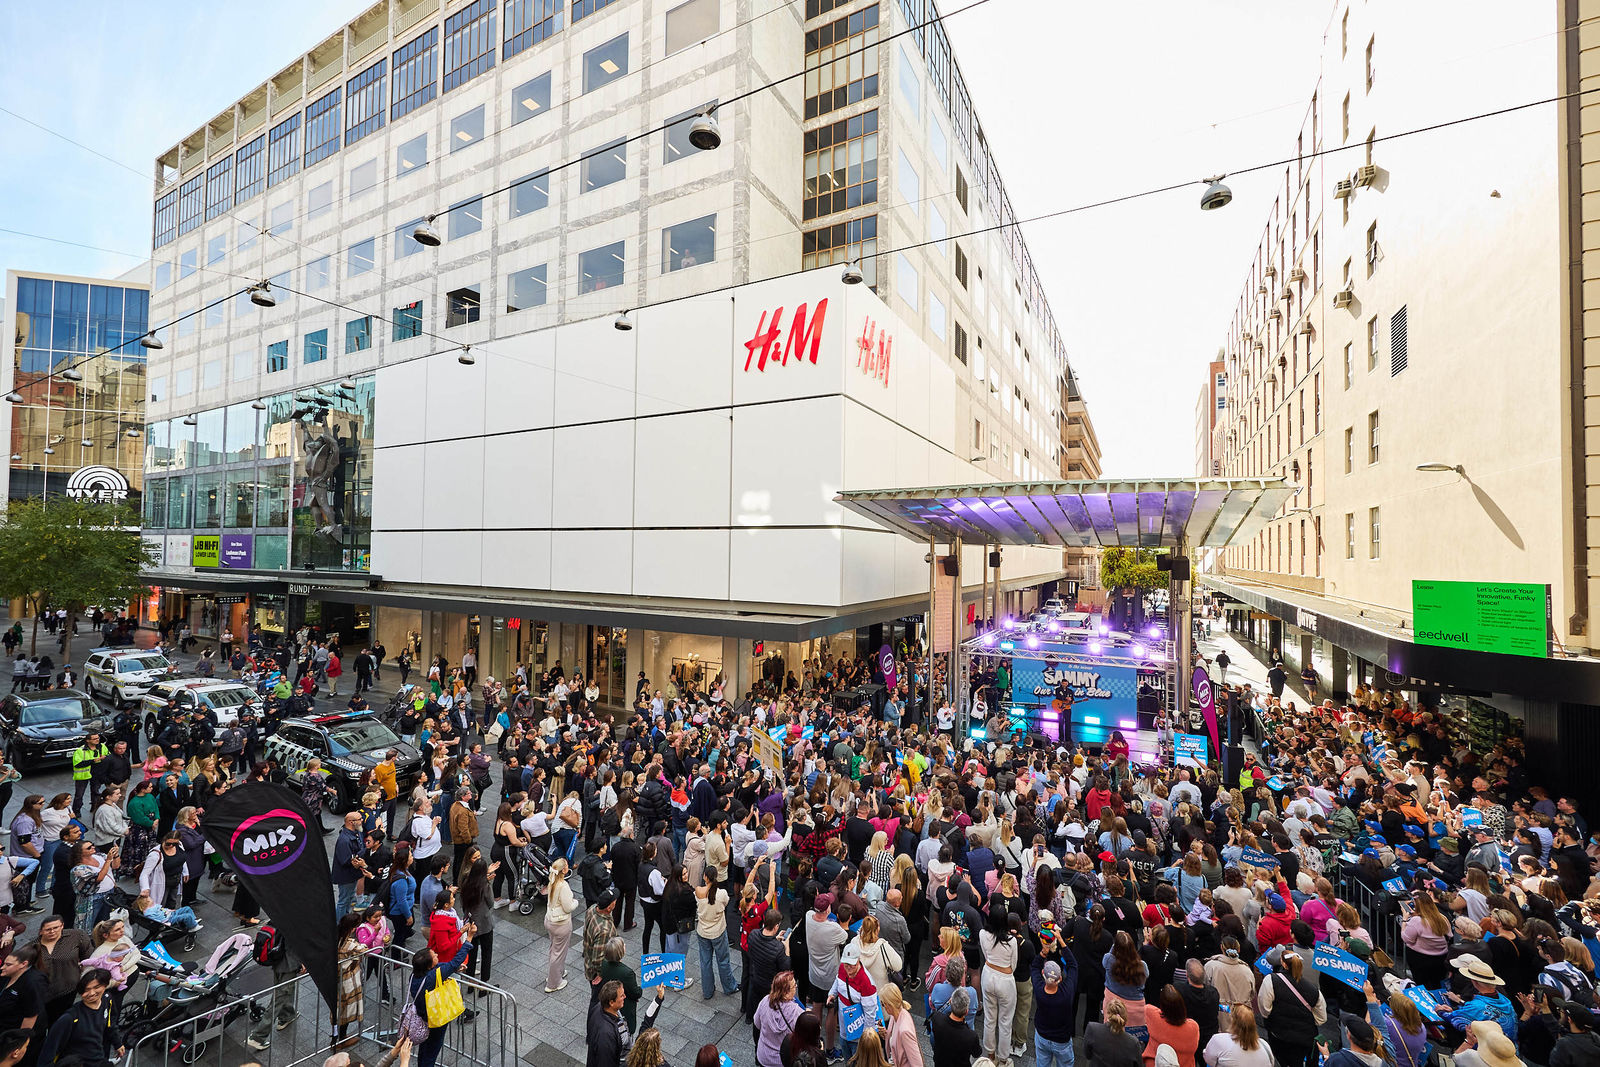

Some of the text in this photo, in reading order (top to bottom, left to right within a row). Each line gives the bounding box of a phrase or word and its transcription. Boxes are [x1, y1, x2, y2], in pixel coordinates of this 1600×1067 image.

[744, 298, 828, 372] H&M
[856, 315, 893, 388] H&M
[66, 489, 128, 499] MYER
[195, 541, 219, 550] JB HI-FI
[1514, 594, 1536, 602] Funky
[1043, 669, 1100, 688] SAMMY
[1033, 685, 1111, 698] Our in Blue
[242, 824, 297, 856] MIX
[253, 845, 290, 862] 102.3
[643, 970, 656, 982] GO
[655, 960, 683, 976] SAMMY
[1315, 957, 1366, 976] GO SAMMY
[1408, 990, 1421, 1002] GO
